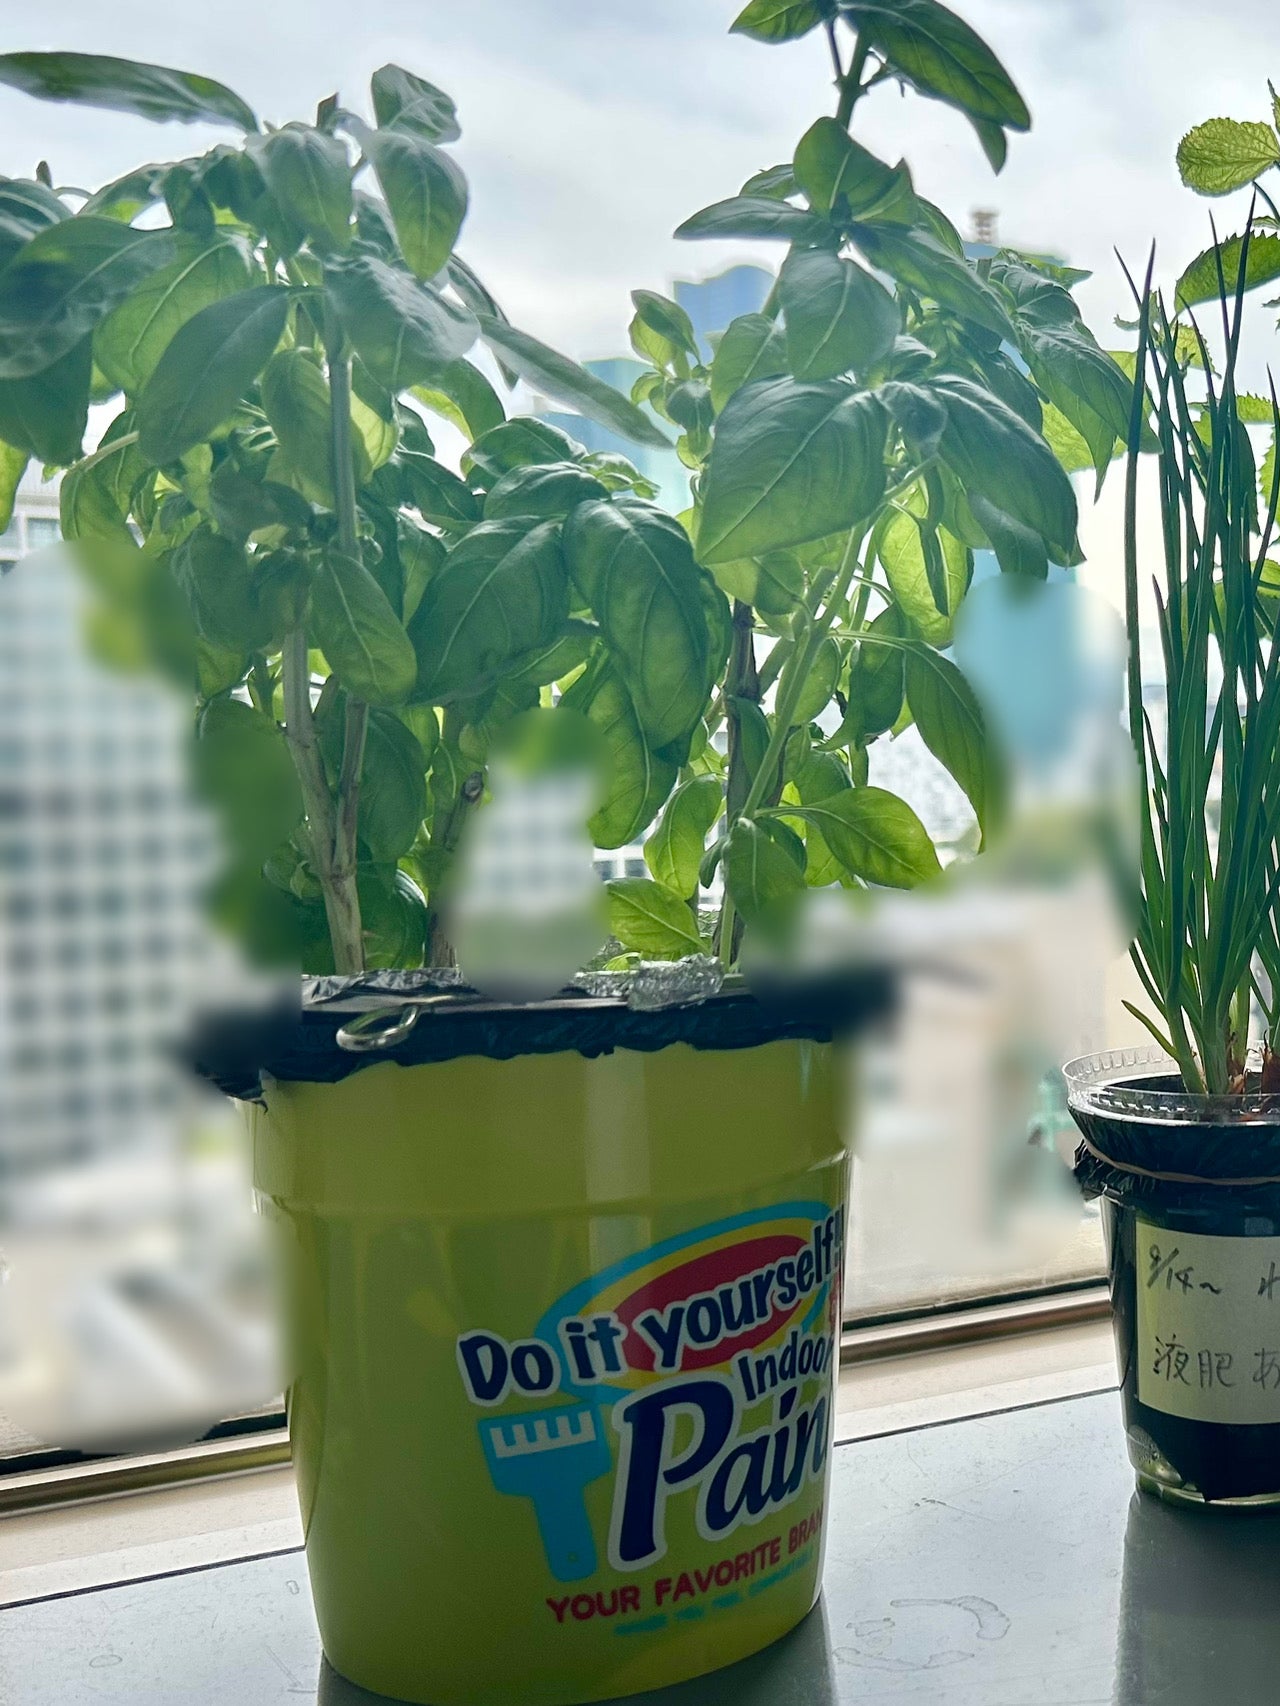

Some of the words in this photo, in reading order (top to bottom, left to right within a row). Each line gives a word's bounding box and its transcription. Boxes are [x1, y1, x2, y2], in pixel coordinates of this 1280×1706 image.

[458, 1334, 554, 1401] Do
[564, 1316, 626, 1379] it
[546, 1585, 641, 1624] YOUR
[654, 1537, 782, 1606] FAVORITE
